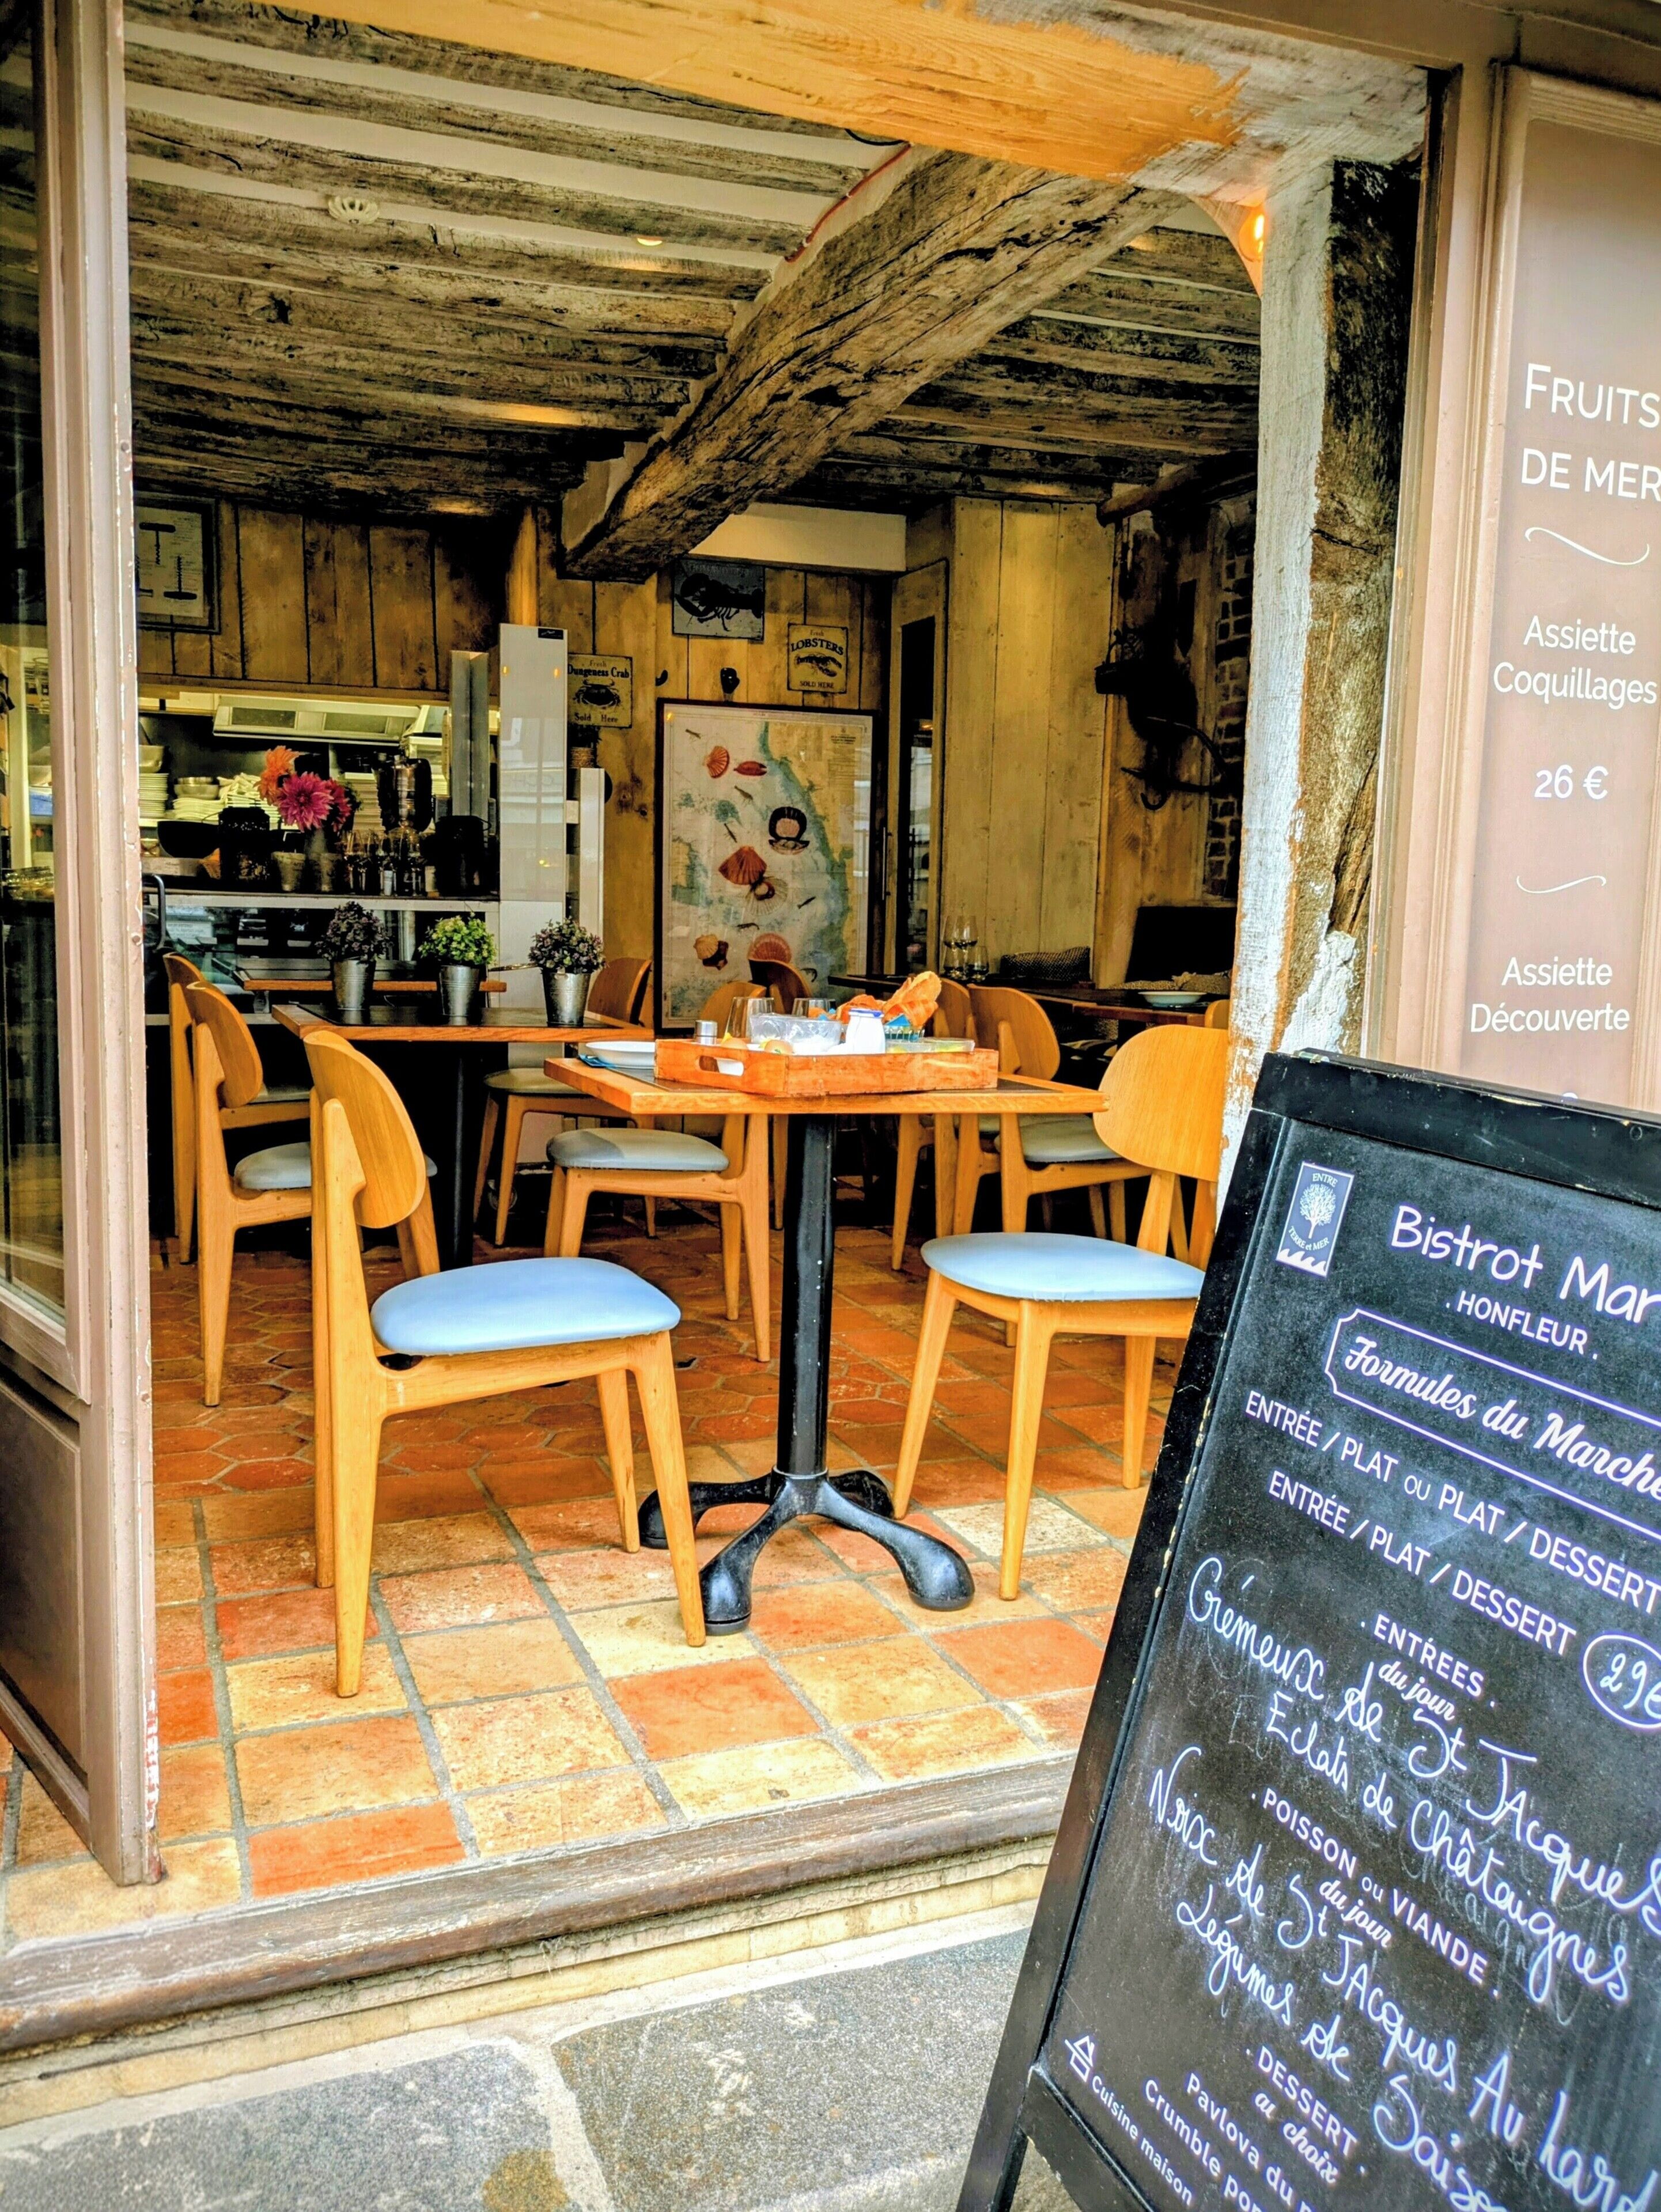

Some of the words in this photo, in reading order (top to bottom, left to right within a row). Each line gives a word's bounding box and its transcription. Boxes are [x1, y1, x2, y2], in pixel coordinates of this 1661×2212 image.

[1524, 363, 1660, 428] FRUITS
[1521, 448, 1571, 490] DE
[1584, 457, 1661, 502] MER
[790, 638, 843, 656] LOBSTERS
[1523, 615, 1636, 654] Assiette
[567, 664, 609, 677] Dungeness
[611, 667, 630, 678] Crab
[1493, 662, 1658, 710] Coquillages
[574, 712, 591, 721] Sold
[601, 714, 618, 722] Here
[1534, 764, 1573, 800] 26
[1583, 766, 1609, 800] €
[1501, 957, 1613, 986] Assiette
[1470, 1002, 1630, 1032] Découverte
[1312, 1173, 1338, 1187] ENTRE
[1288, 1226, 1306, 1249] TERRE
[1312, 1237, 1330, 1251] MER
[1391, 1205, 1543, 1289] Bistrot
[1560, 1256, 1661, 1323] Mar
[1456, 1290, 1588, 1354] HONFLEUR
[1344, 1336, 1478, 1419] Formules
[1482, 1399, 1531, 1440] du
[1245, 1390, 1323, 1448] ENTRÉE
[1341, 1436, 1399, 1483] PLAT
[1403, 1475, 1431, 1501] OU
[1438, 1484, 1505, 1535] PLAT
[1528, 1528, 1661, 1613] DESSERT
[1269, 1470, 1350, 1534] ENTRÉE
[1369, 1524, 1431, 1575] PLAT
[1451, 1569, 1577, 1656] DESSERT
[1334, 1661, 1383, 1743] de
[1408, 1707, 1467, 1778] St
[1378, 1661, 1408, 1690] du
[1401, 1676, 1455, 1721] jour
[1363, 1771, 1397, 1828] de
[1263, 1787, 1357, 1878] POISSON
[1392, 1888, 1488, 1985] VIANDE
[1319, 1880, 1348, 1910] du
[1340, 1899, 1392, 1948] jour
[1149, 1746, 1218, 1866] Noix
[1226, 1843, 1265, 1916] de
[1277, 1874, 1327, 1949] St
[1469, 2051, 1524, 2142] Au
[1176, 1883, 1294, 2026] Légumes
[1300, 2014, 1350, 2082] de
[1144, 2079, 1221, 2177] Crumble
[1258, 2046, 1358, 2157] DESSERT
[1091, 2075, 1138, 2140] Cuisine
[1140, 2136, 1194, 2206] maison
[1187, 2072, 1261, 2169] Pavlova
[1266, 2165, 1295, 2206] du
[1254, 2092, 1276, 2119] au
[1282, 2122, 1339, 2184] choix
